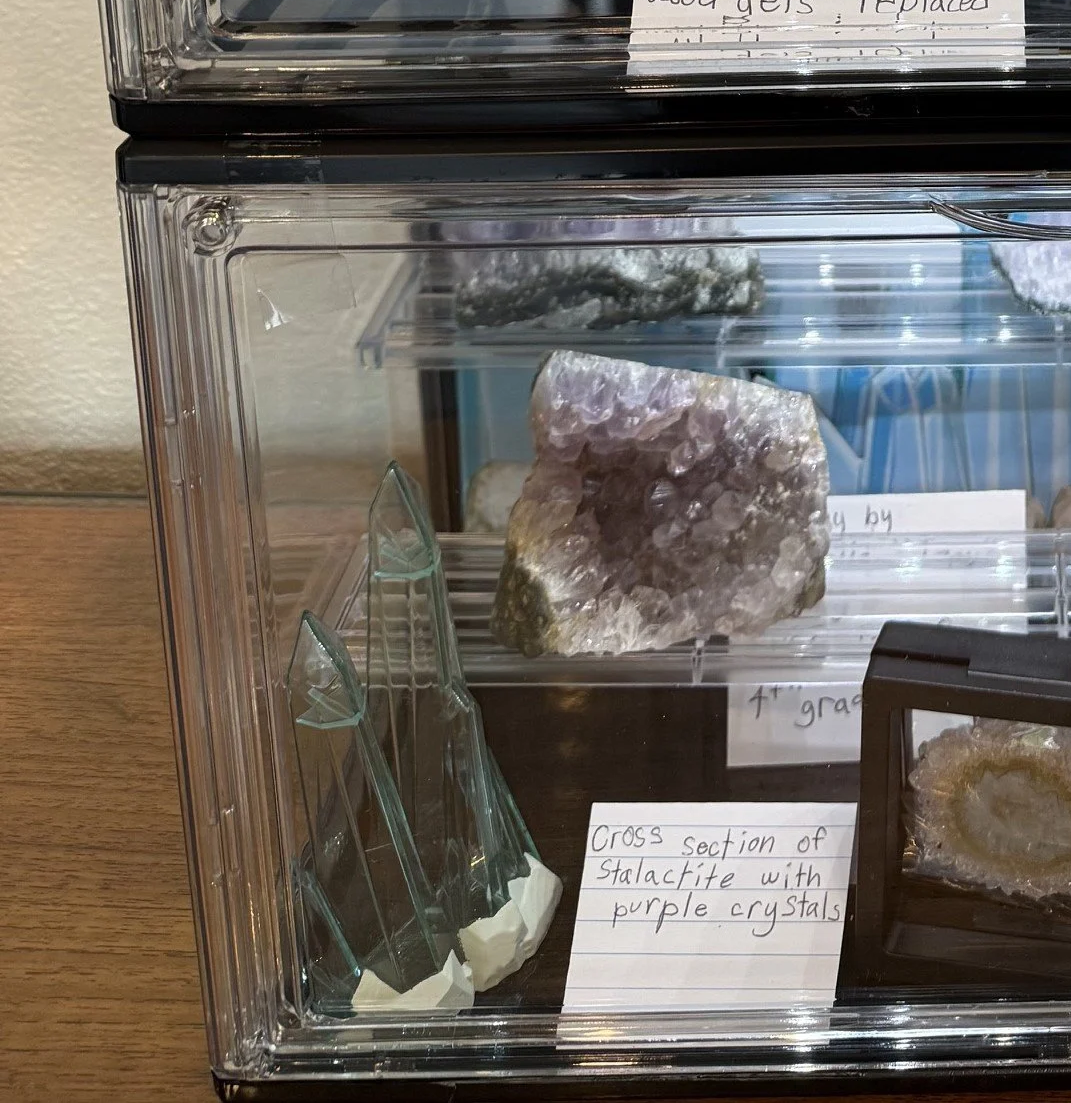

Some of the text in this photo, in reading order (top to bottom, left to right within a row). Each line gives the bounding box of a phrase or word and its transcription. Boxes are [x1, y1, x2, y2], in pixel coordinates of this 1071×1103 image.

[865, 503, 893, 534] by
[591, 824, 664, 852] Cross
[796, 826, 828, 854] of
[761, 861, 821, 890] with
[612, 891, 709, 935] purple
